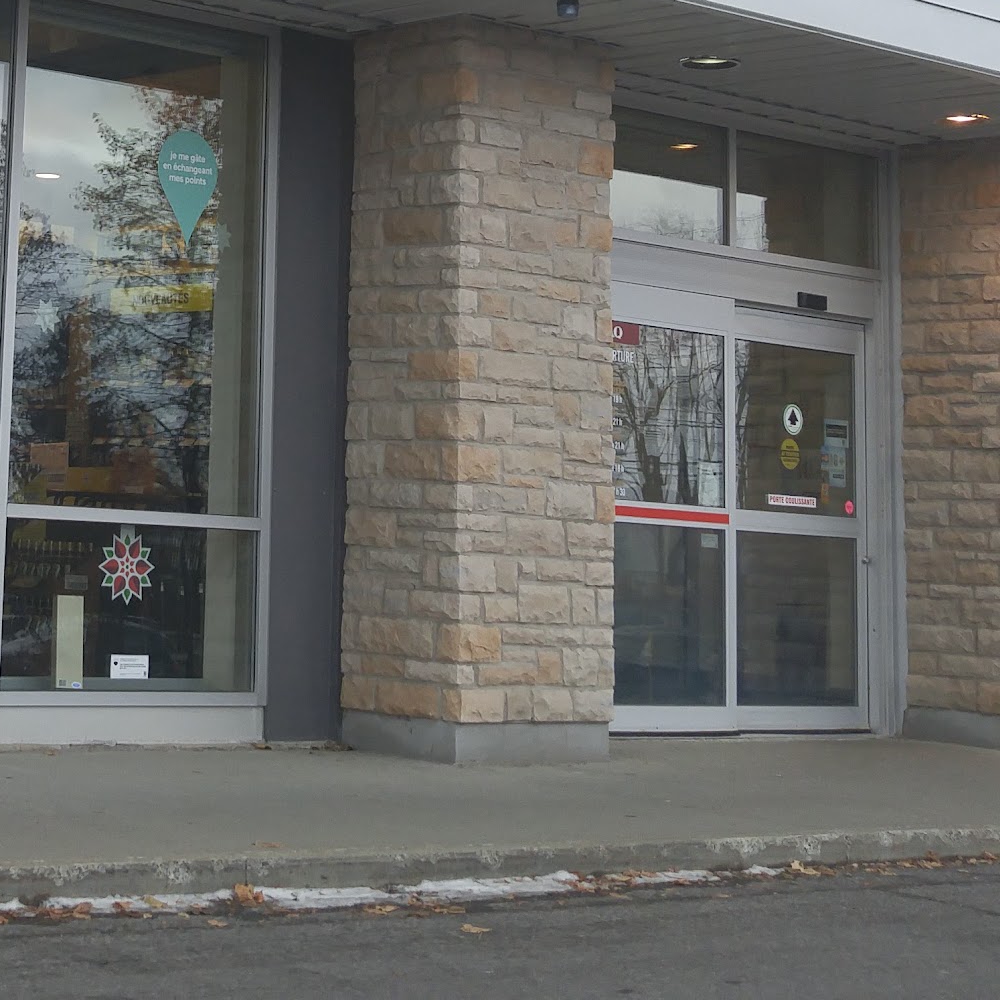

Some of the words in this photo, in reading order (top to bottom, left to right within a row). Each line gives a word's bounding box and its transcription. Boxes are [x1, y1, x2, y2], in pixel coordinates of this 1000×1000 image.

[162, 162, 172, 170] en
[173, 162, 213, 175] échangeant
[184, 176, 207, 186] points
[612, 326, 623, 339] Q
[612, 350, 634, 363] RTURE
[769, 495, 785, 504] PORTE
[785, 497, 815, 506] COULISSANTE
